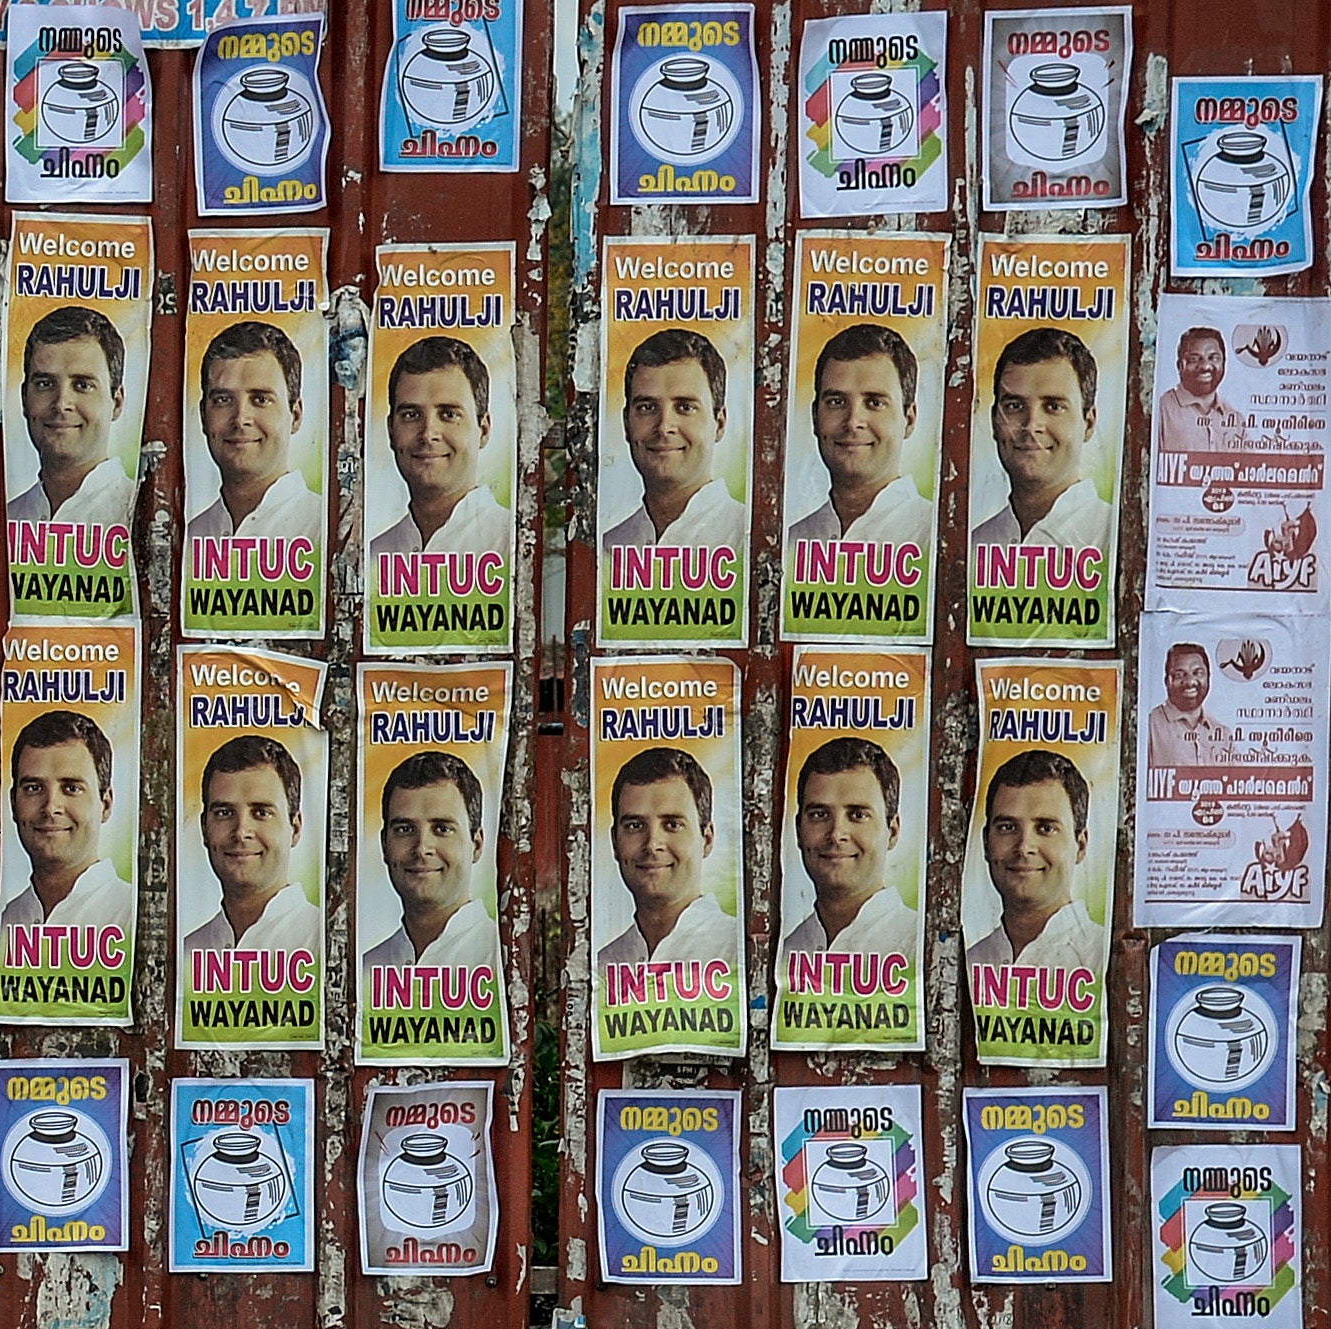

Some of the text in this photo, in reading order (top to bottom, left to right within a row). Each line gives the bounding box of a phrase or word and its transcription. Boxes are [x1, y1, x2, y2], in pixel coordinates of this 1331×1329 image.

[217, 32, 315, 61] നമ്മുടെ
[637, 21, 740, 50] നമ്മുടെ
[1194, 94, 1298, 125] നമ്മുടെ
[223, 183, 317, 205] ചിഹ്നം
[638, 171, 735, 194] ചിഹ്നം
[19, 232, 136, 258] Welcome
[1193, 237, 1290, 263] ചിഹ്നം
[192, 248, 309, 273] Welcome
[616, 255, 734, 280] Welcome
[990, 254, 1108, 279] Welcome
[17, 263, 140, 297] RAHULJI
[190, 280, 316, 313] RAHULJI
[614, 284, 740, 320] RAHULJI
[986, 285, 1114, 319] RAHULJI
[1157, 452, 1186, 483] AIYF
[192, 537, 313, 580] INTUC
[611, 546, 736, 589] INTUC
[977, 545, 1101, 588] INTUC
[379, 552, 503, 595] INTUC
[190, 588, 314, 617] WAYANAD
[376, 602, 505, 631] WAYANAD
[607, 597, 736, 625] WAYANAD
[972, 596, 1100, 627] WAYANAD
[371, 680, 488, 705] Welcome
[602, 676, 718, 703] Welcome
[988, 679, 1101, 702] Welcome
[371, 710, 495, 744] RAHULJI
[601, 706, 725, 740] RAHULJI
[988, 709, 1106, 742] RAHULJI
[1148, 769, 1175, 799] AIYF
[192, 950, 314, 992] INTUC
[788, 952, 908, 995] INTUC
[1173, 950, 1276, 980] നമ്മുടെ
[371, 966, 493, 1009] INTUC
[607, 961, 730, 1002] INTUC
[190, 1000, 315, 1028] WAYANAD
[605, 1008, 734, 1038] WAYANAD
[784, 1003, 909, 1030] WAYANAD
[369, 1016, 496, 1045] WAYANAD
[6, 1075, 107, 1103] നമ്മുടെ
[804, 1107, 894, 1137] നമ്മുടെ
[1172, 1094, 1269, 1121] ചിഹ്നം
[12, 1219, 105, 1244] ചിഹ്നം
[814, 1229, 894, 1257] ചിഹ്നം
